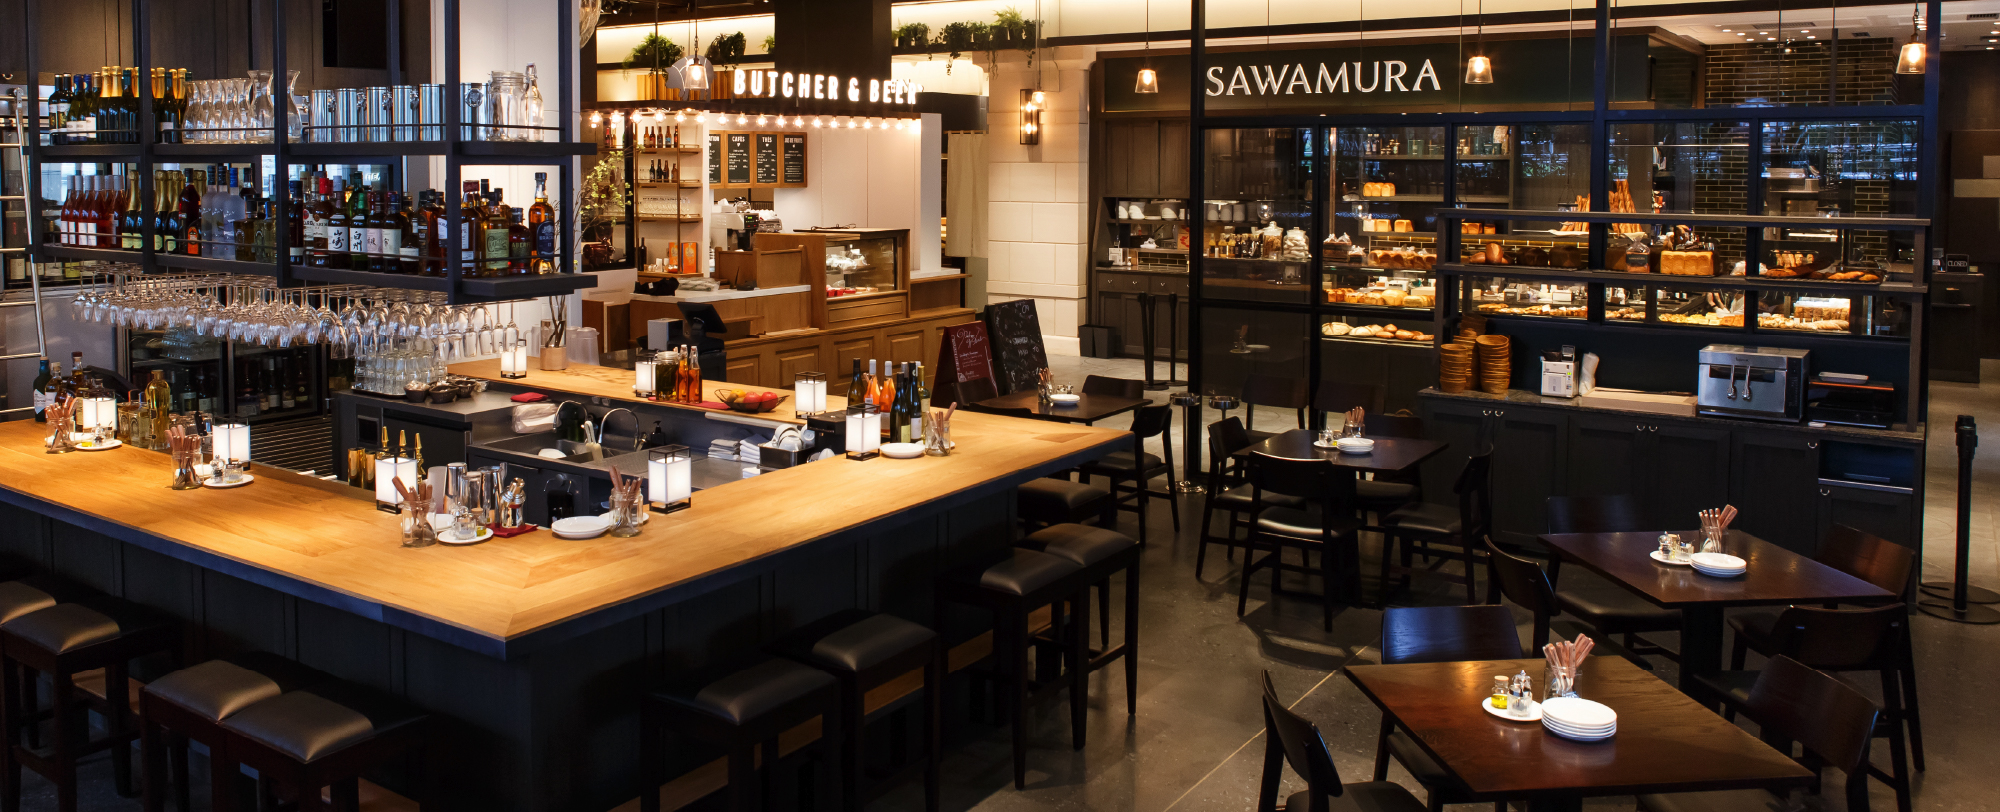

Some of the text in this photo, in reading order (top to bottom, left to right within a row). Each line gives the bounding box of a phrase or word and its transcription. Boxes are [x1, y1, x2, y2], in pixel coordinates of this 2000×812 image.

[733, 69, 839, 100] BUTCHER
[848, 77, 860, 102] &
[869, 79, 917, 105] BEER
[1205, 58, 1441, 97] SAWAMURA
